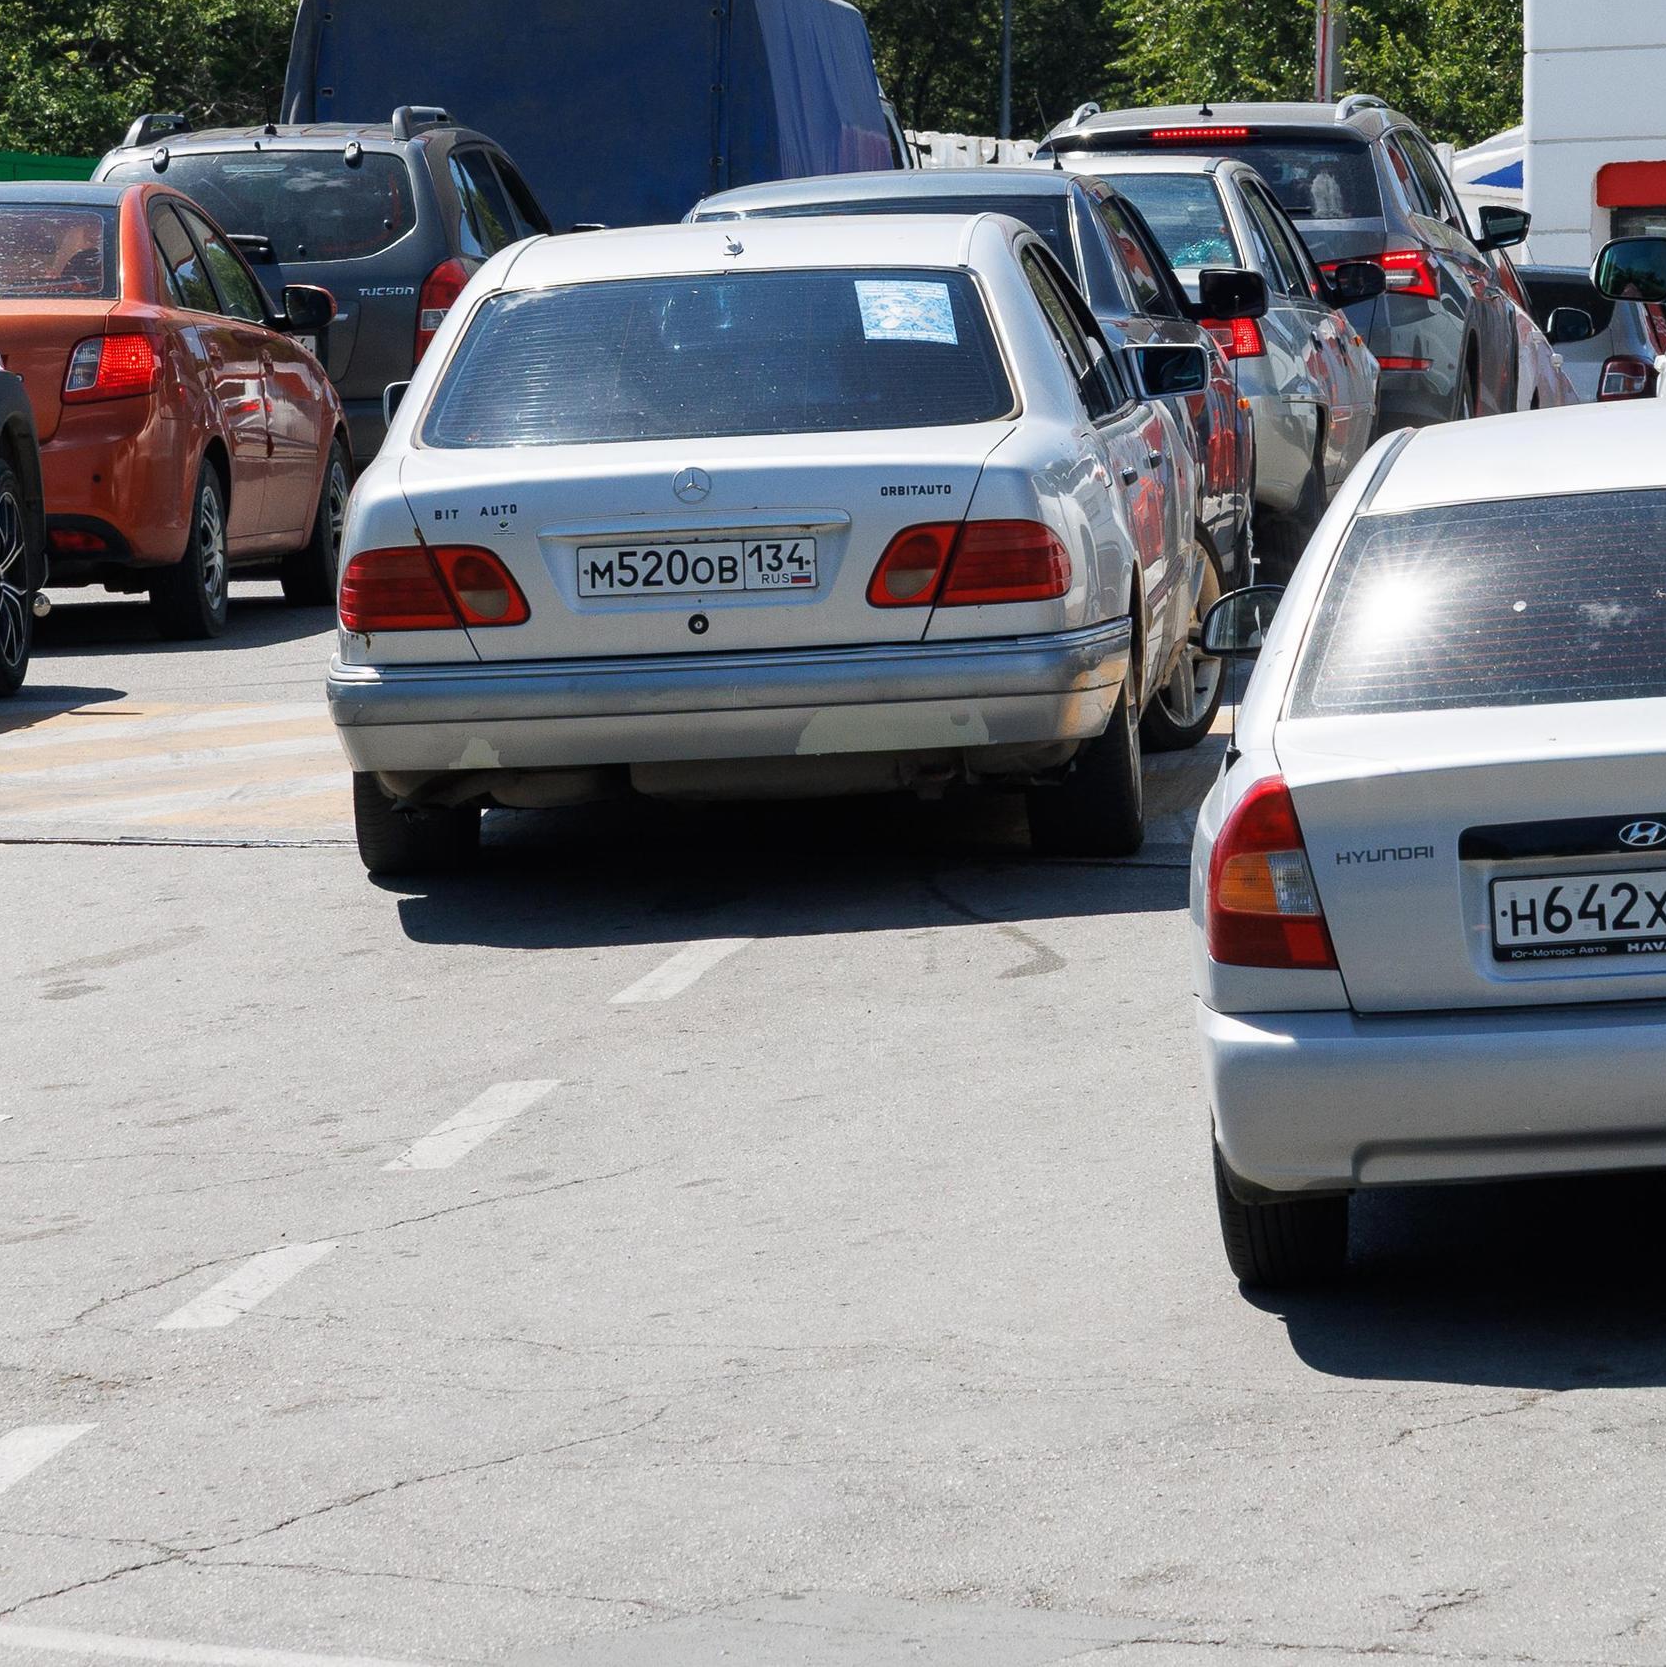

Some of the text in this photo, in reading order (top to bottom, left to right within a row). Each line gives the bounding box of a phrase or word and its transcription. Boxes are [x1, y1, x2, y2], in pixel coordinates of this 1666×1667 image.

[358, 286, 414, 297] TUCSON
[880, 484, 951, 496] ORBITAUTO
[434, 504, 517, 520] BIT AUTO
[590, 543, 804, 589] М520ОВ 134
[762, 573, 790, 584] RUS
[1336, 844, 1434, 864] HYUNDAI
[1511, 945, 1607, 959] Юг-Моторс Авто
